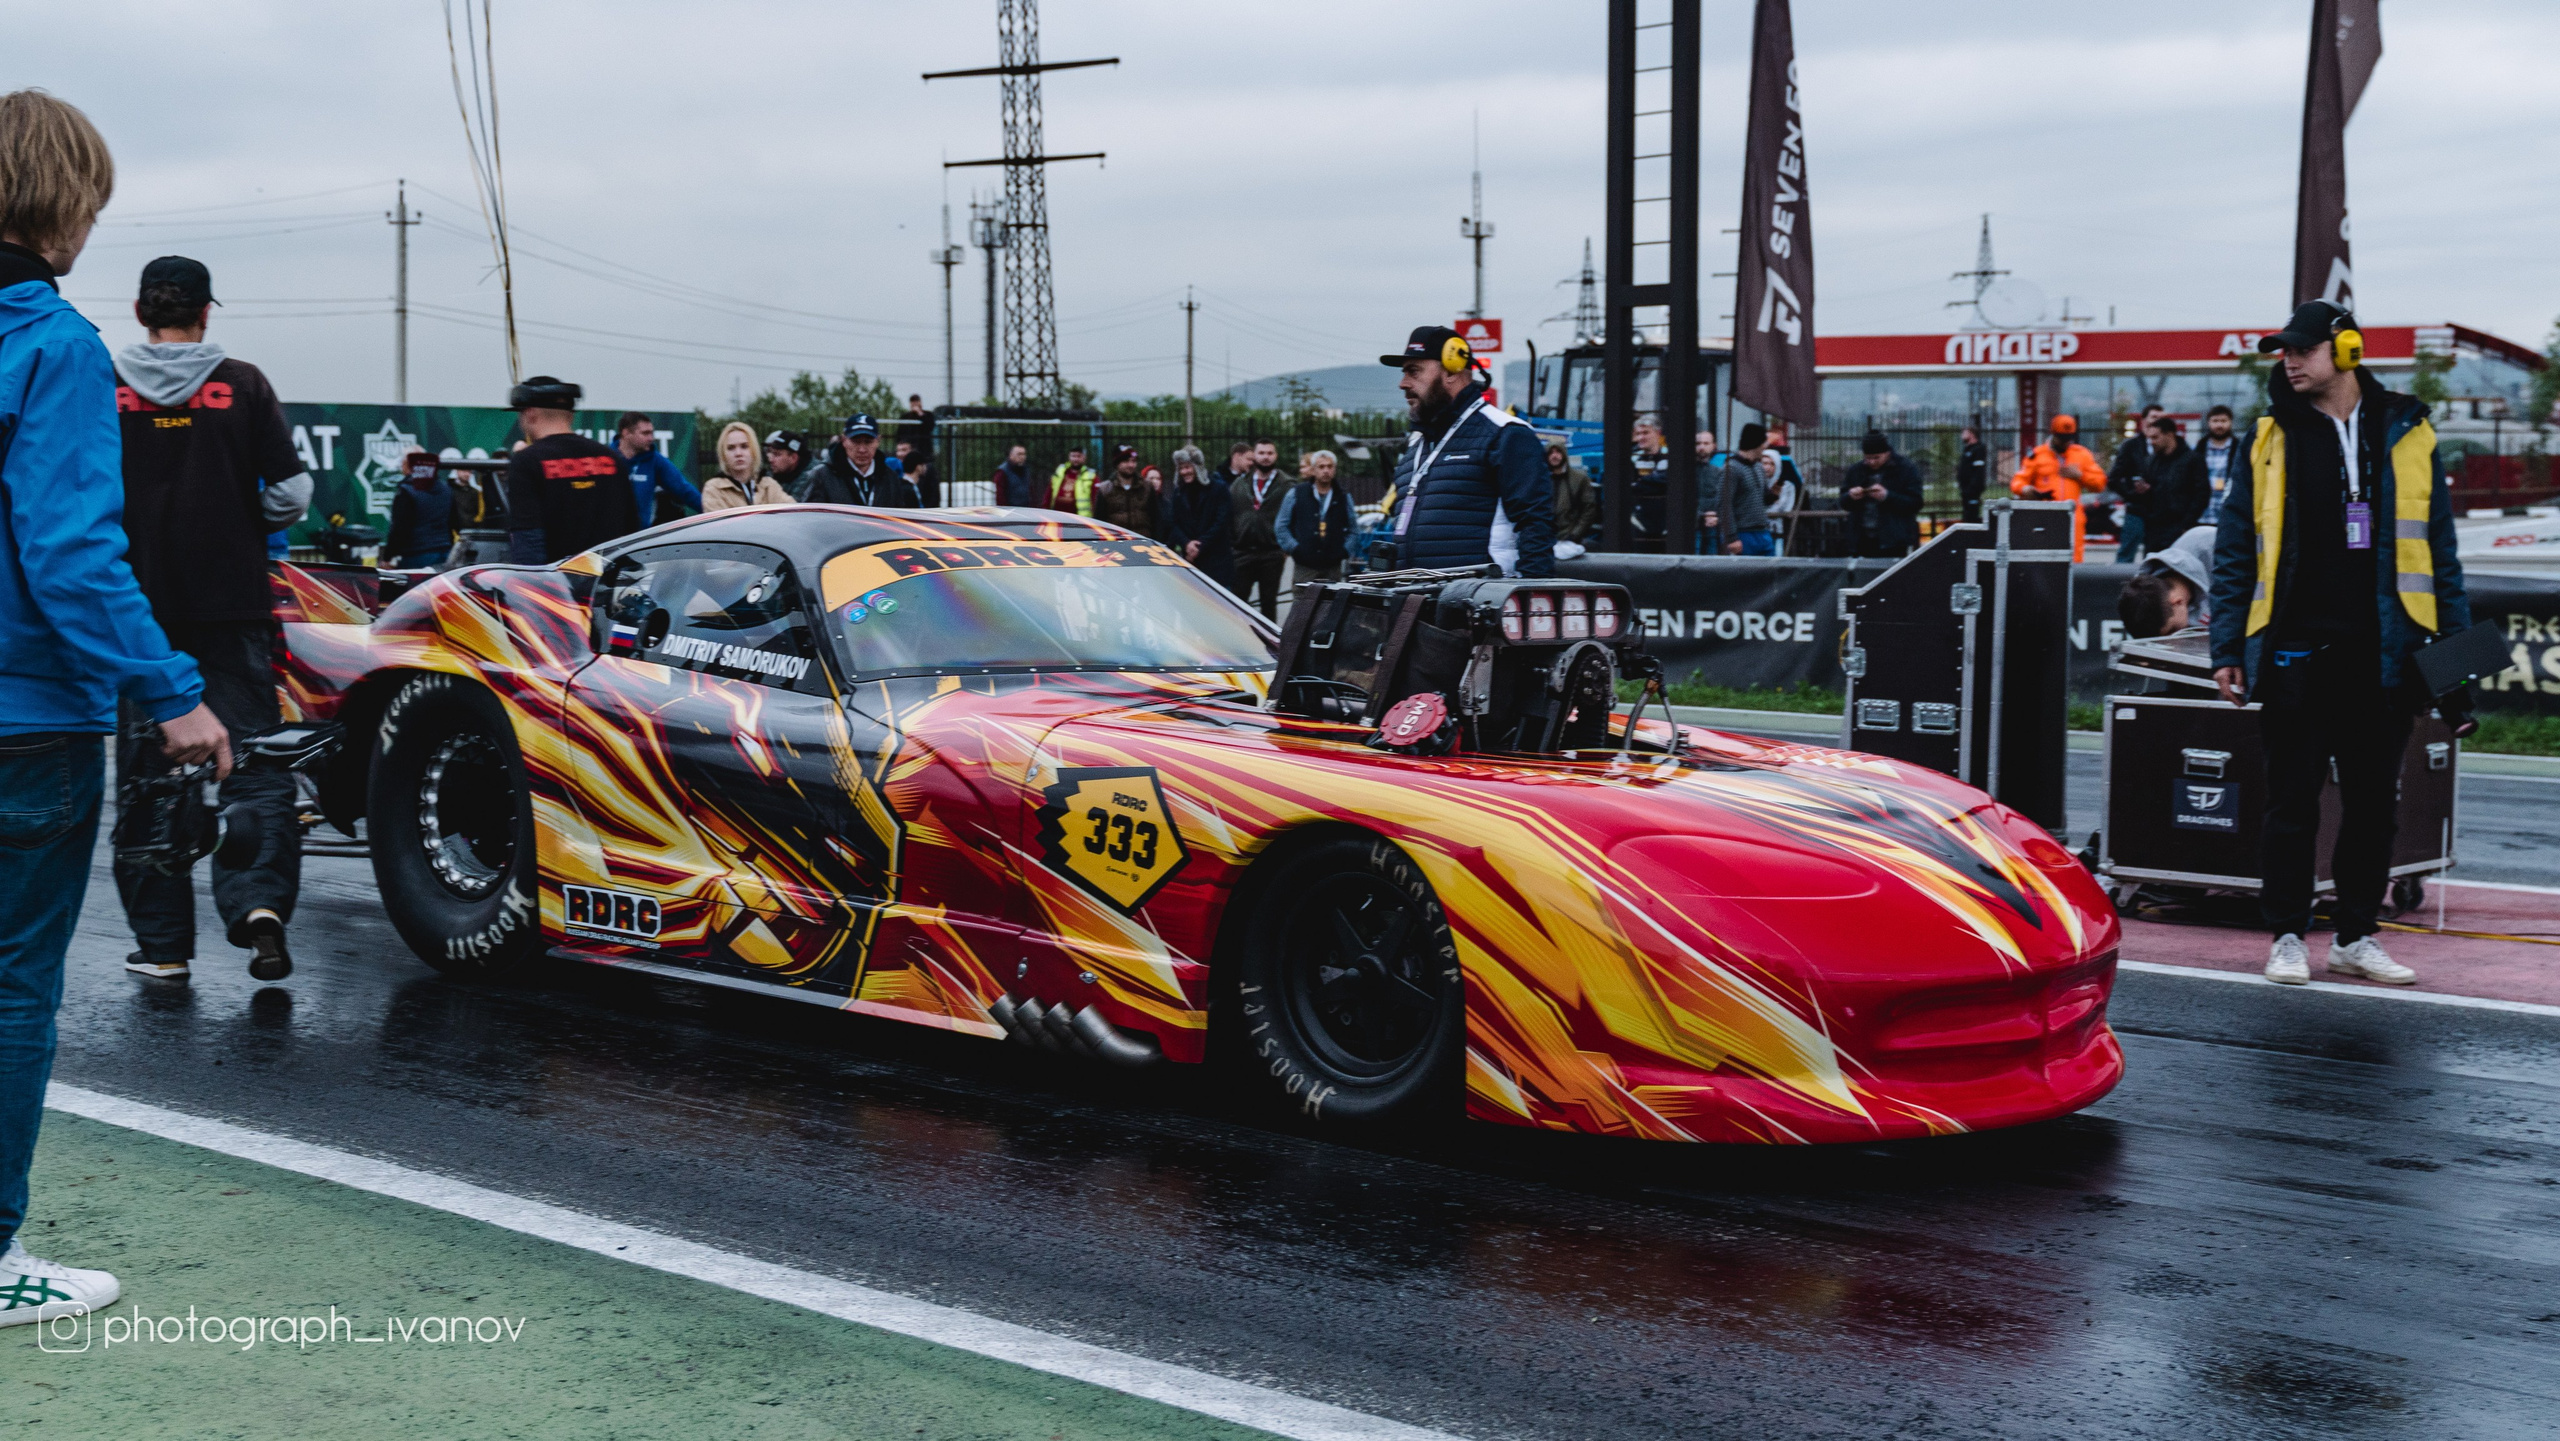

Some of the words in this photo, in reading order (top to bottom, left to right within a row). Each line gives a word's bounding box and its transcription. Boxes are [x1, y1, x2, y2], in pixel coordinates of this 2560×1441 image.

[1770, 119, 1803, 260] SEVEN
[1945, 333, 2079, 363] ЛИДЕР
[2219, 333, 2283, 355] АЗ
[152, 417, 192, 428] TEAM
[872, 546, 1067, 577] RDRC
[1635, 608, 1685, 638] EN
[1694, 610, 1816, 642] FORCE
[661, 634, 724, 664] DMITRIY
[719, 645, 811, 680] SAMORUKOV
[1396, 701, 1429, 736] MSD
[1112, 792, 1148, 812] RDRC
[1084, 806, 1159, 870] 333
[562, 884, 662, 938] RDRC
